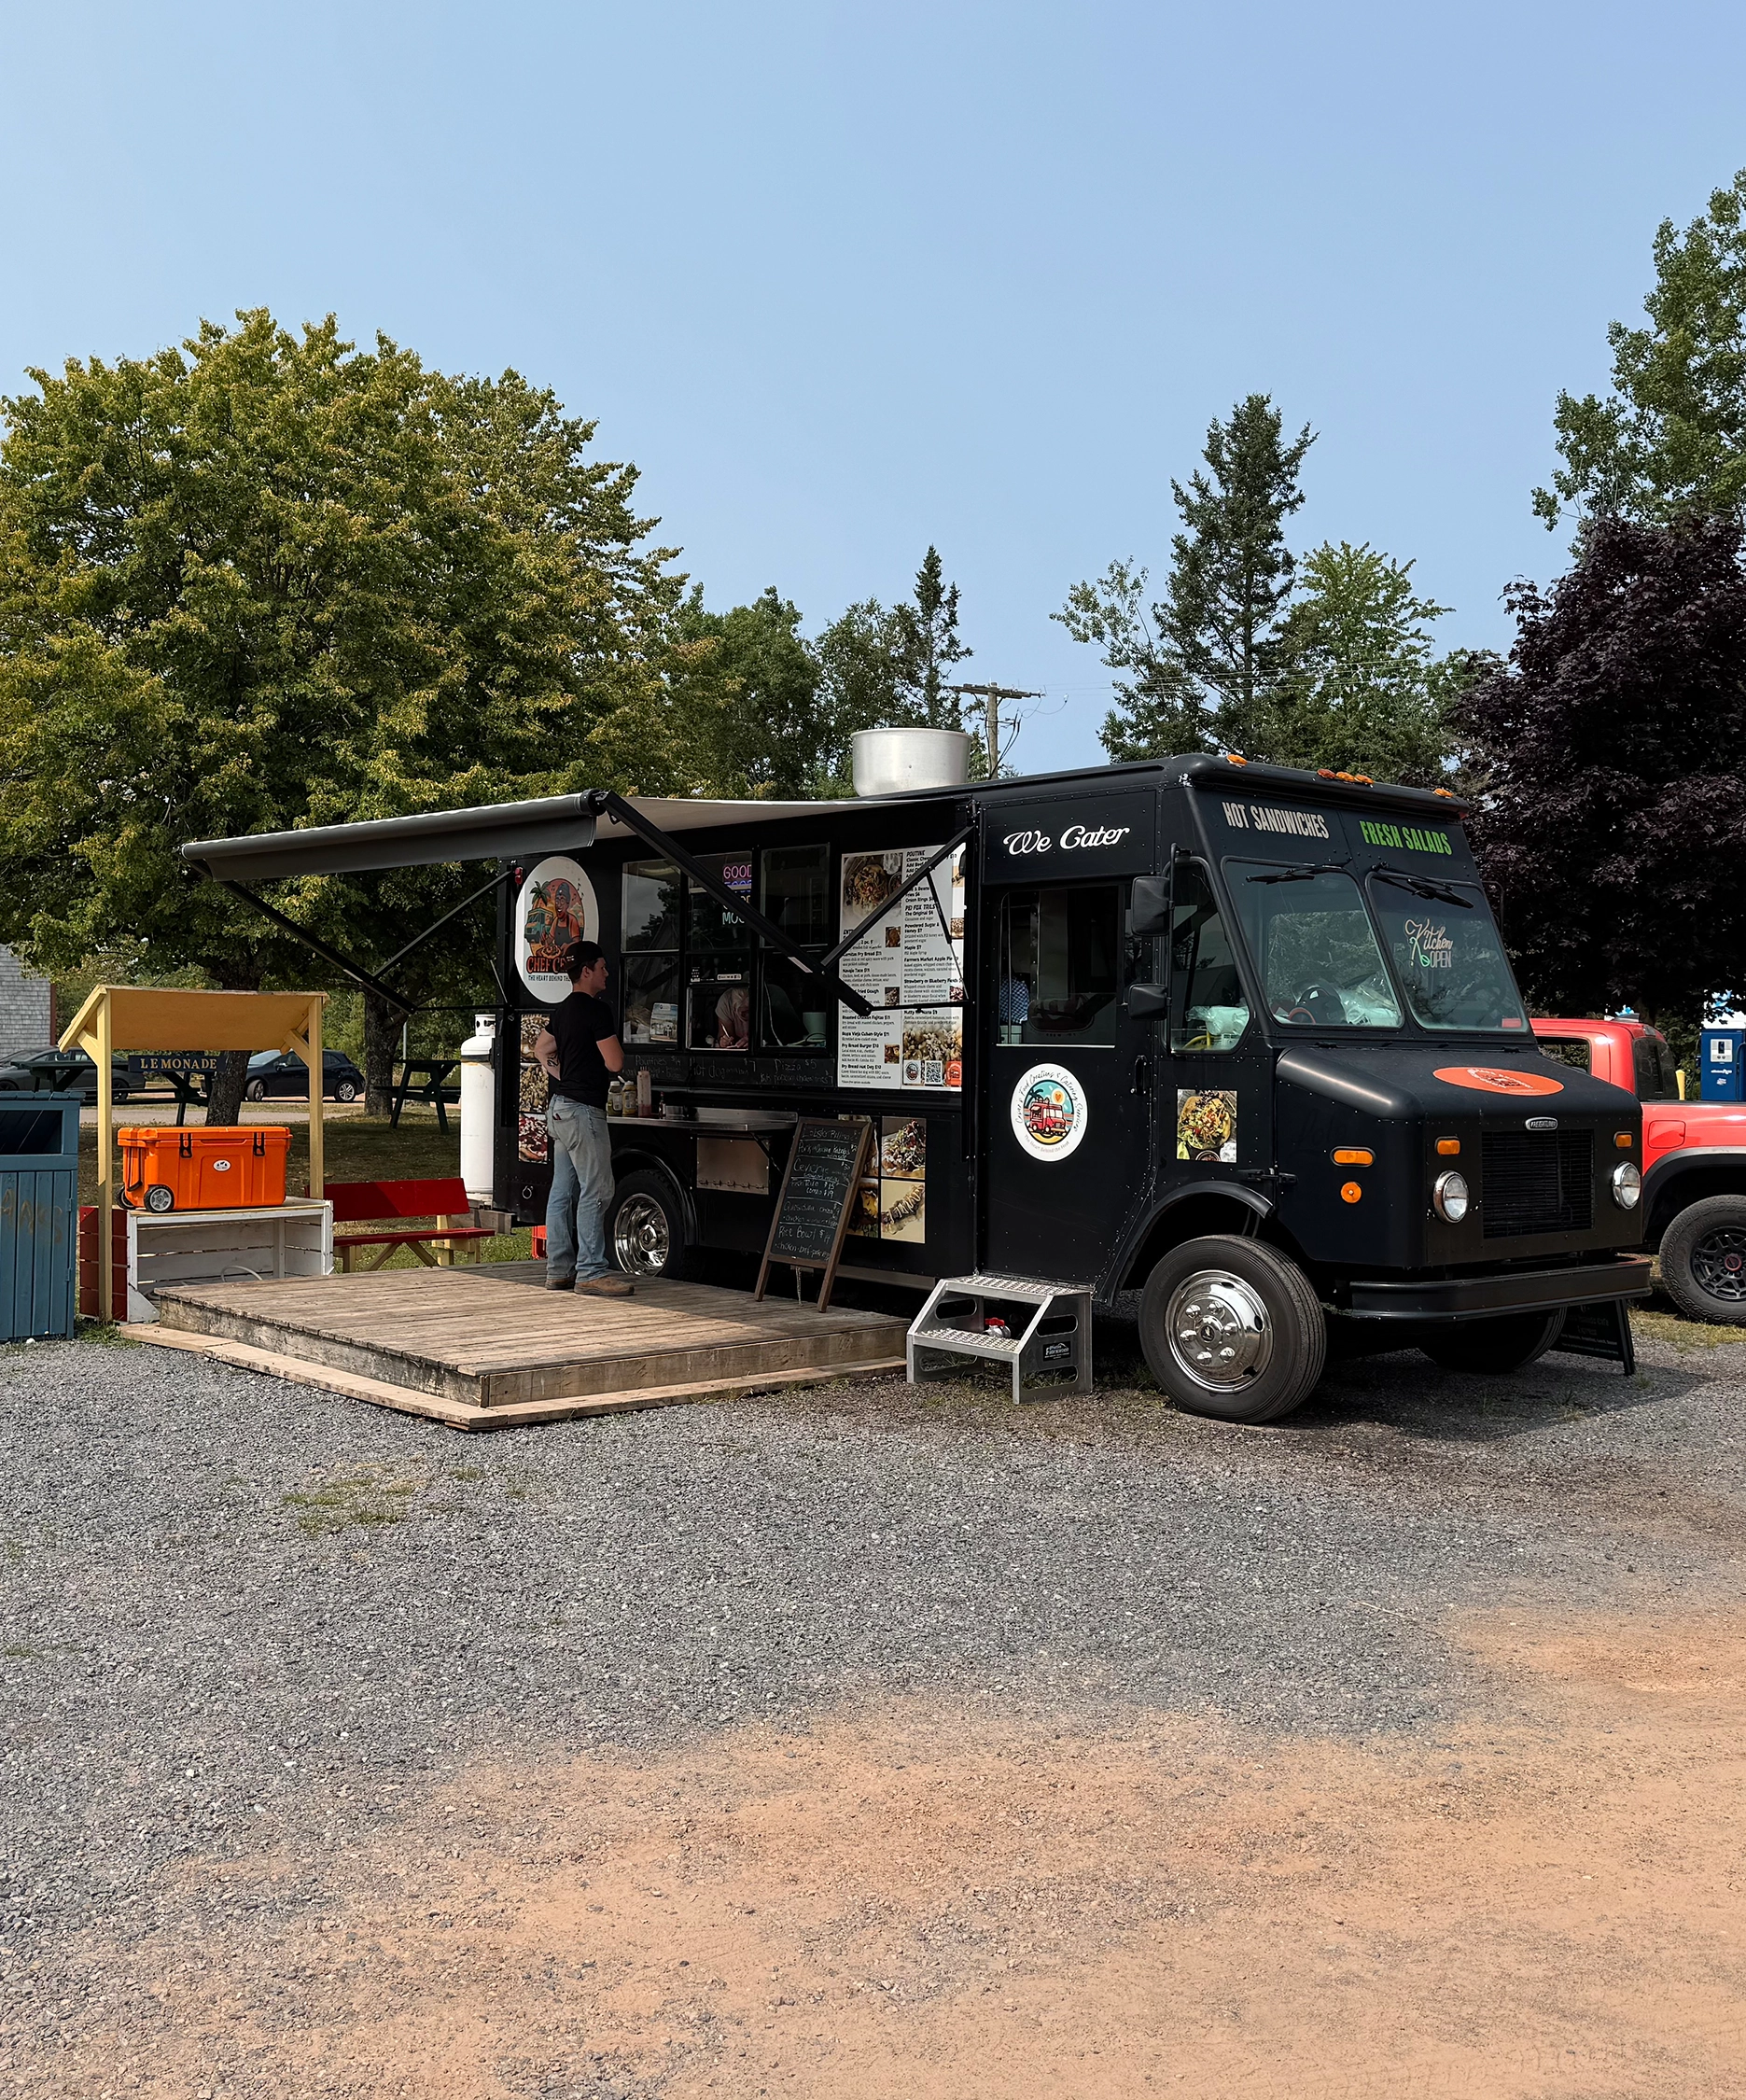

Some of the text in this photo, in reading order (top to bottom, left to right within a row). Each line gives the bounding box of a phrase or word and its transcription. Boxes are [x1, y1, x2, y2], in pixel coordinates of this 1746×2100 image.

[1222, 802, 1330, 839] HOT SANDWICHES
[1003, 825, 1130, 855] We Cater
[1359, 820, 1453, 856] FRESH SALADS
[1404, 918, 1453, 966] Kitchen
[527, 956, 551, 973] CHEF
[1430, 950, 1452, 968] OPEN
[140, 1057, 217, 1071] LEMONADE
[774, 1058, 802, 1074] Pizza
